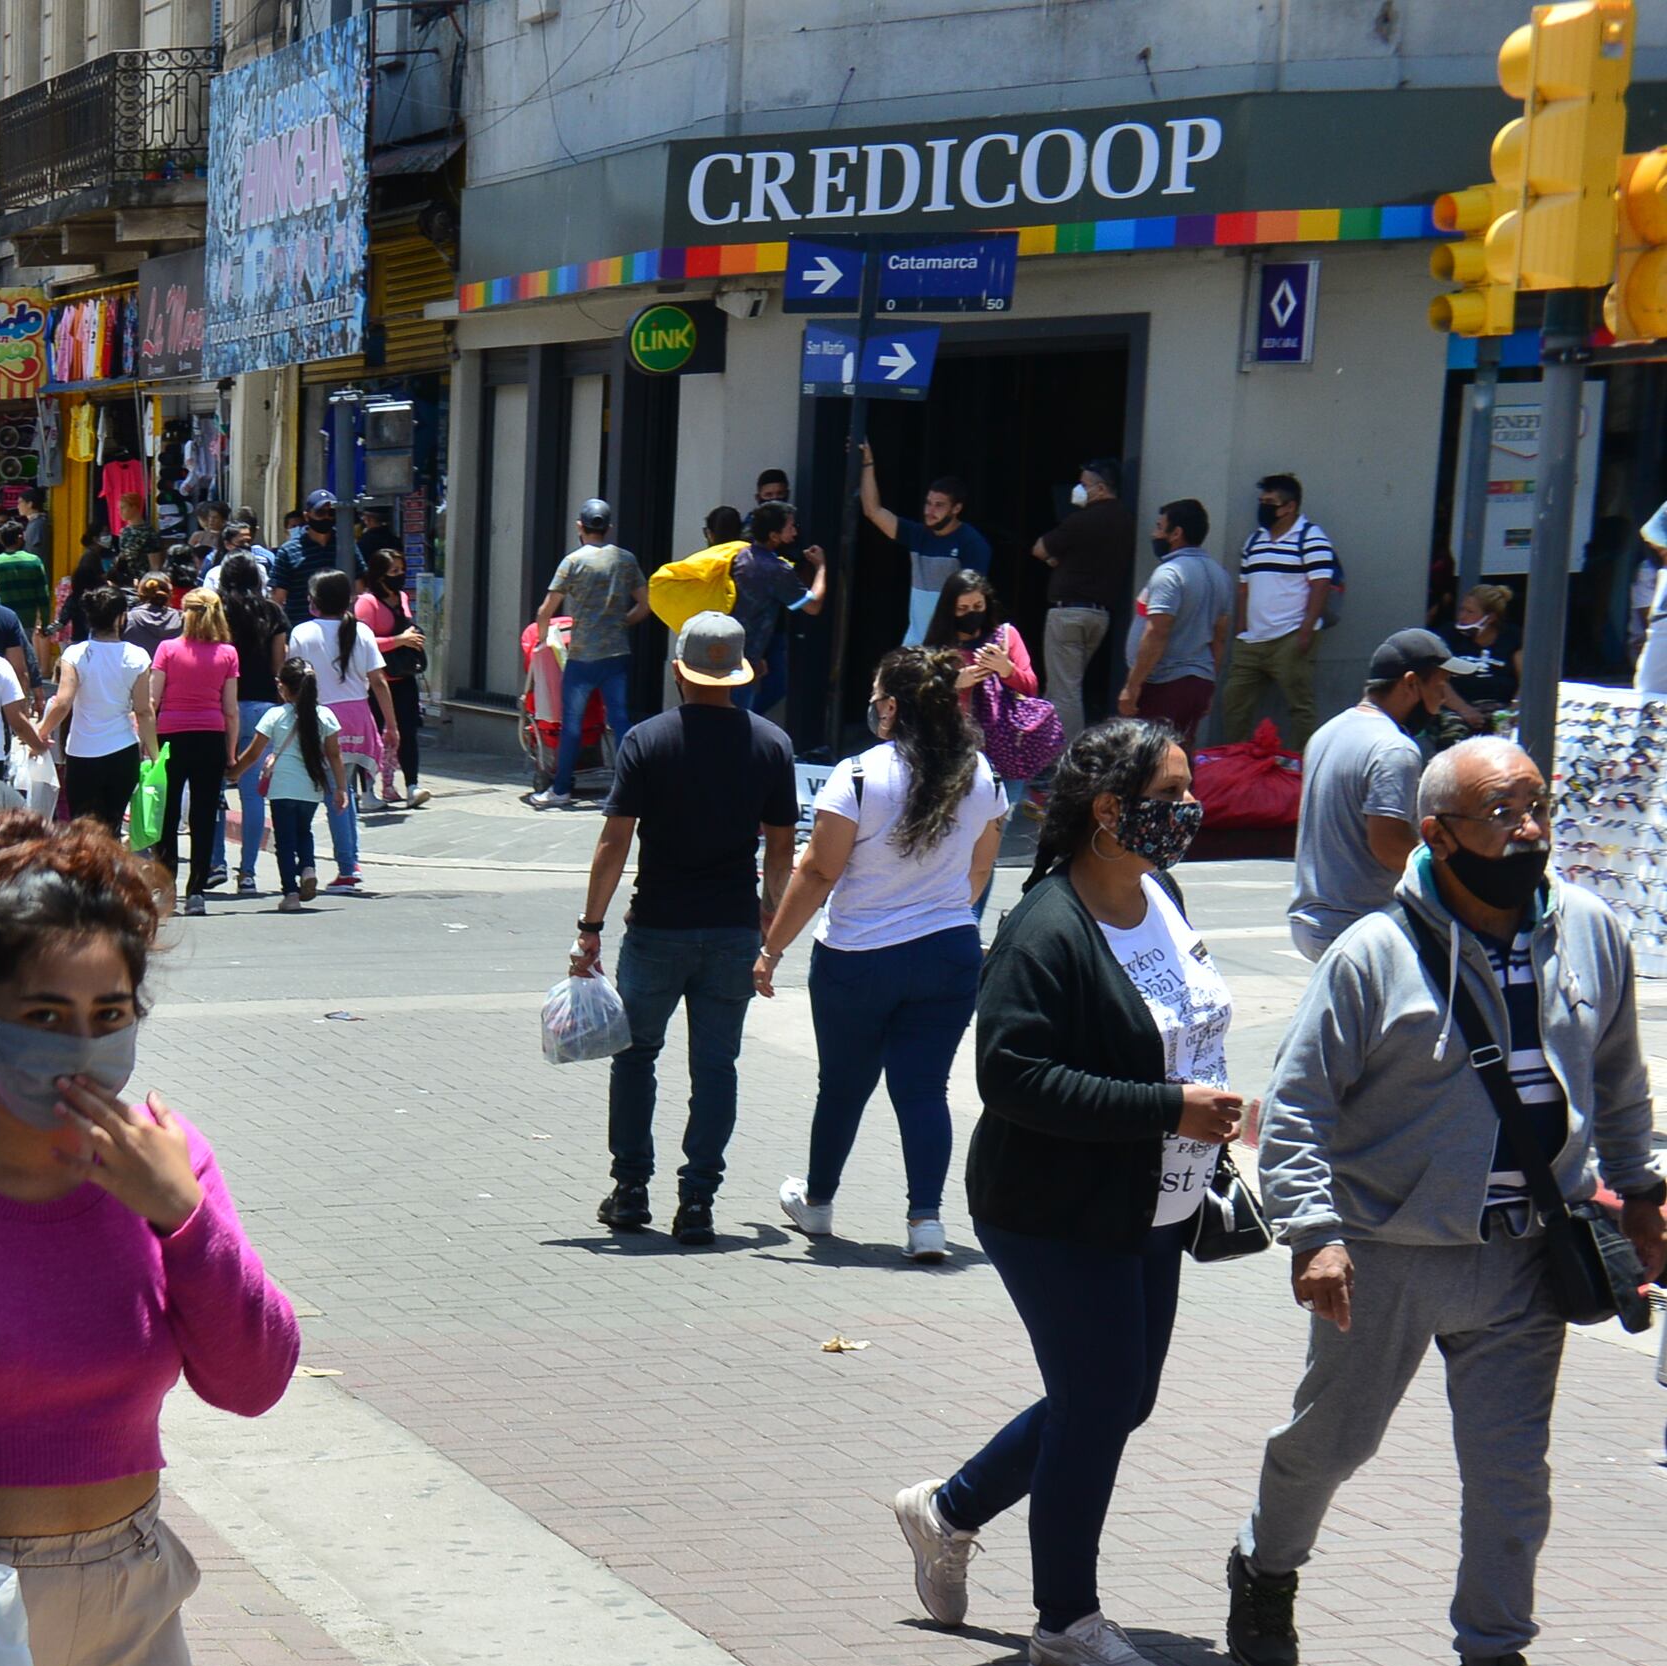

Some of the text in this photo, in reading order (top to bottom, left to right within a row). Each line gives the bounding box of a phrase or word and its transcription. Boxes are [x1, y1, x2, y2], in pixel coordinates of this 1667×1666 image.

[240, 113, 348, 231] HINCHA
[687, 118, 1223, 227] CREDICOOP
[887, 255, 979, 270] Catamarca
[885, 299, 1004, 311] 0 50
[638, 322, 694, 352] LINK
[805, 340, 821, 354] San
[1495, 415, 1540, 429] ENEFI
